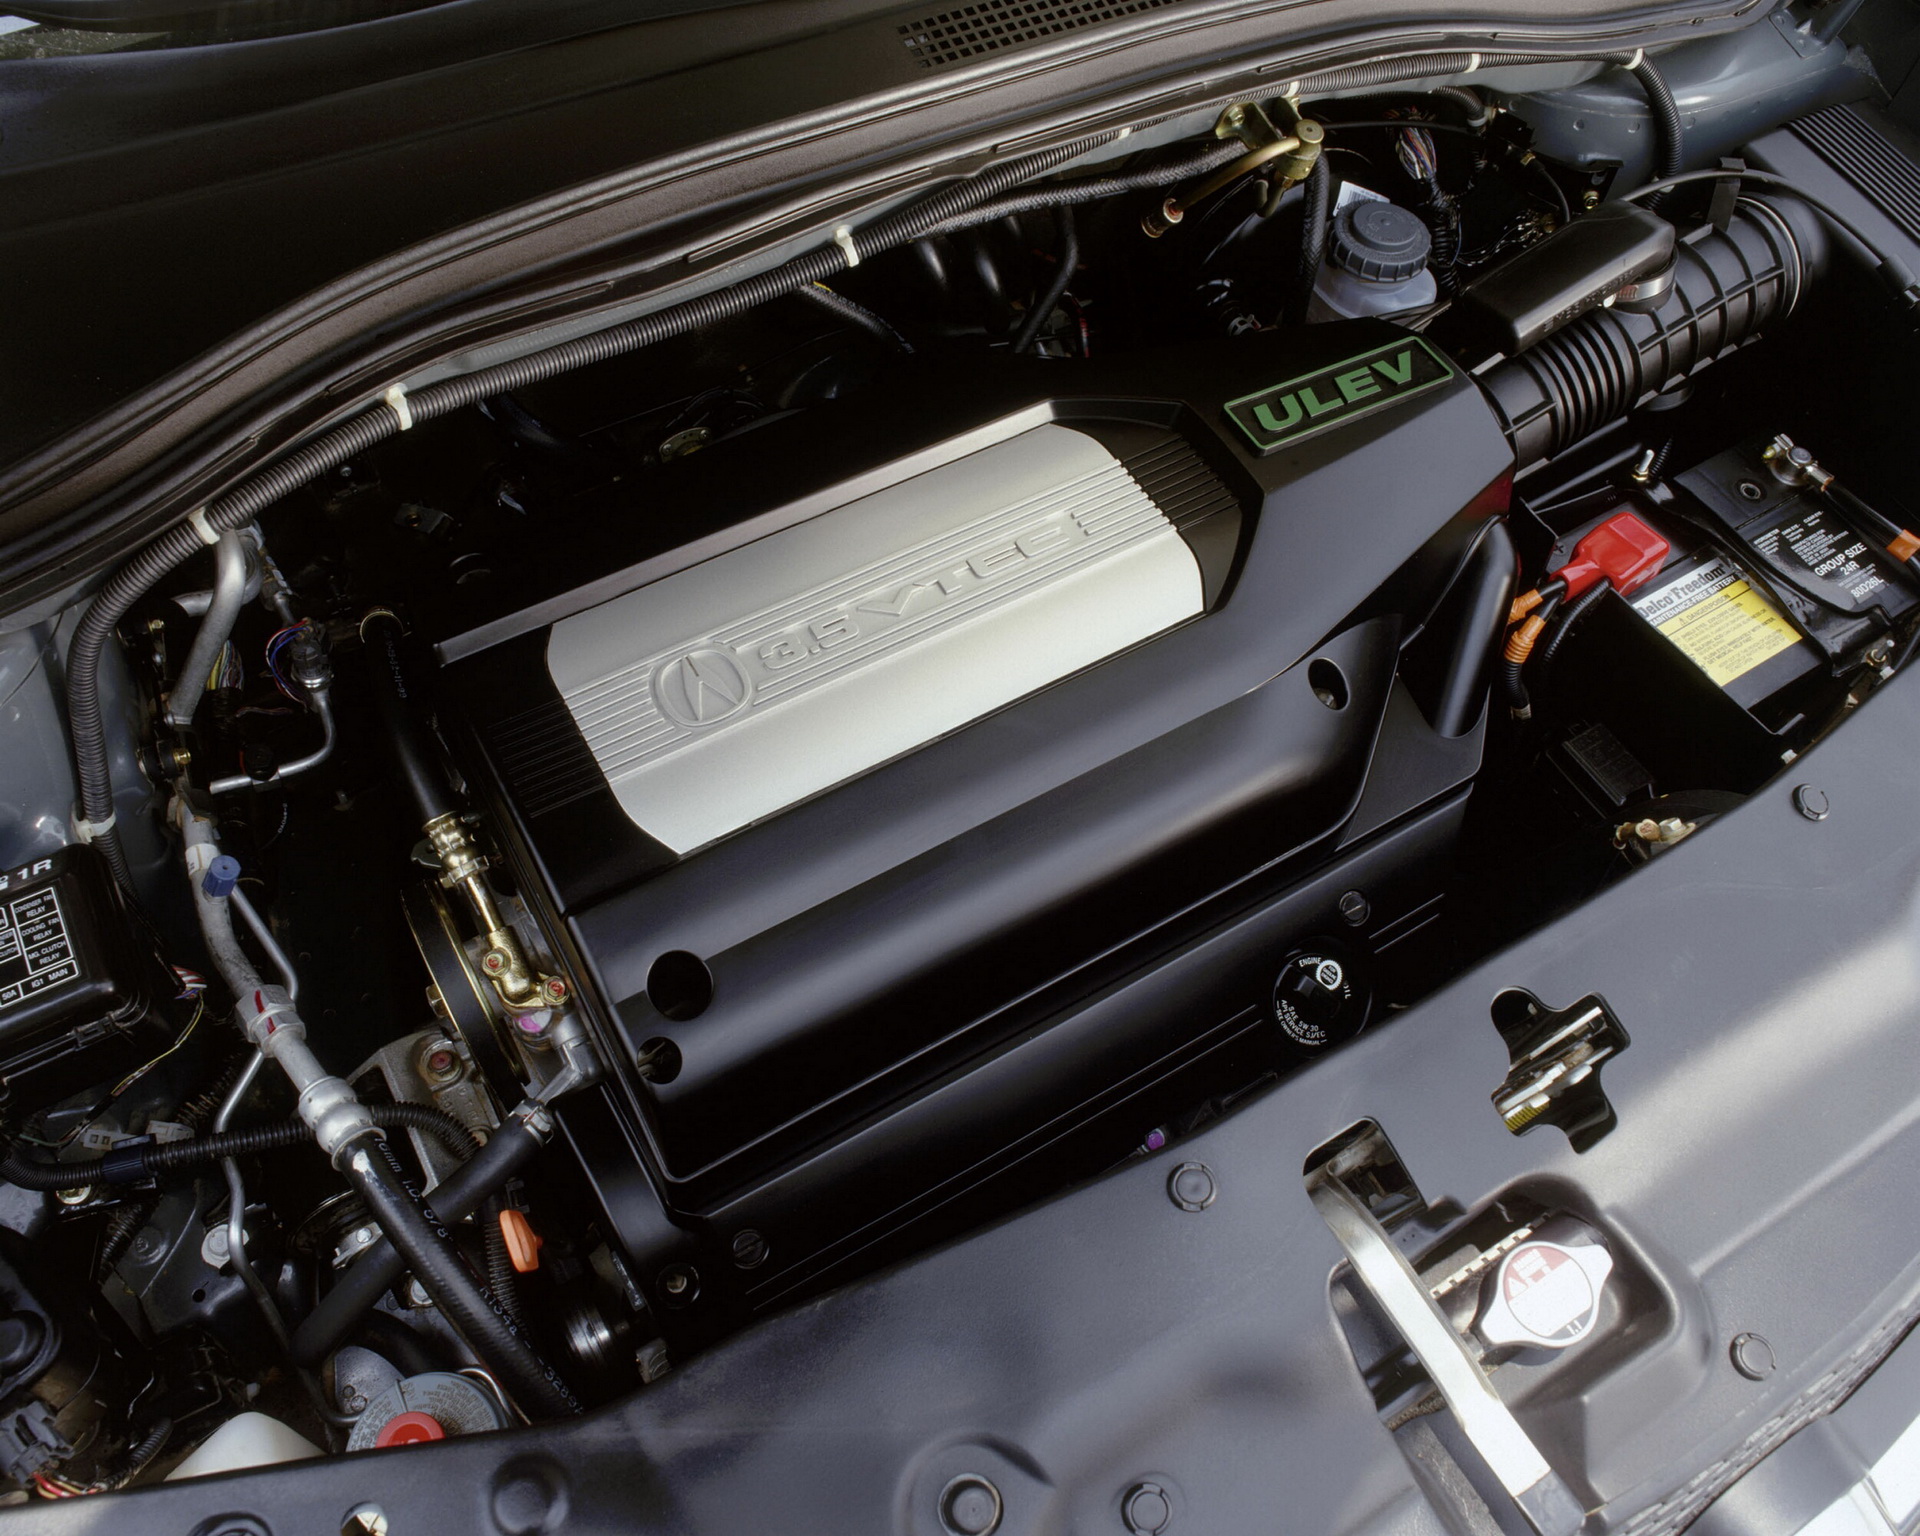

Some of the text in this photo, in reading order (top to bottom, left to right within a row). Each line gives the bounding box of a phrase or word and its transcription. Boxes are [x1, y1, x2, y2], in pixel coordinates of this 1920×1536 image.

[1253, 350, 1412, 432] ULEV
[856, 520, 1071, 617] VTEC
[1815, 553, 1846, 576] GROUP
[1844, 542, 1867, 558] SIZE
[1840, 560, 1860, 575] 24R
[1636, 565, 1726, 619] Delco Freedom
[1707, 575, 1736, 594] BATTERY
[1851, 576, 1884, 598] 80D26L
[17, 859, 52, 880] 1R
[26, 905, 46, 918] RELAY
[21, 917, 60, 937] COOLING FAN
[33, 929, 53, 941] RELAY
[41, 940, 67, 955] CLUTCH
[39, 952, 60, 965] RELAY
[1299, 957, 1321, 967] ENGINE
[31, 967, 69, 988] IG1 MAIN
[1288, 1006, 1299, 1021] SAE
[1284, 1012, 1304, 1036] SERVICE
[1299, 1038, 1321, 1046] MANUAL
